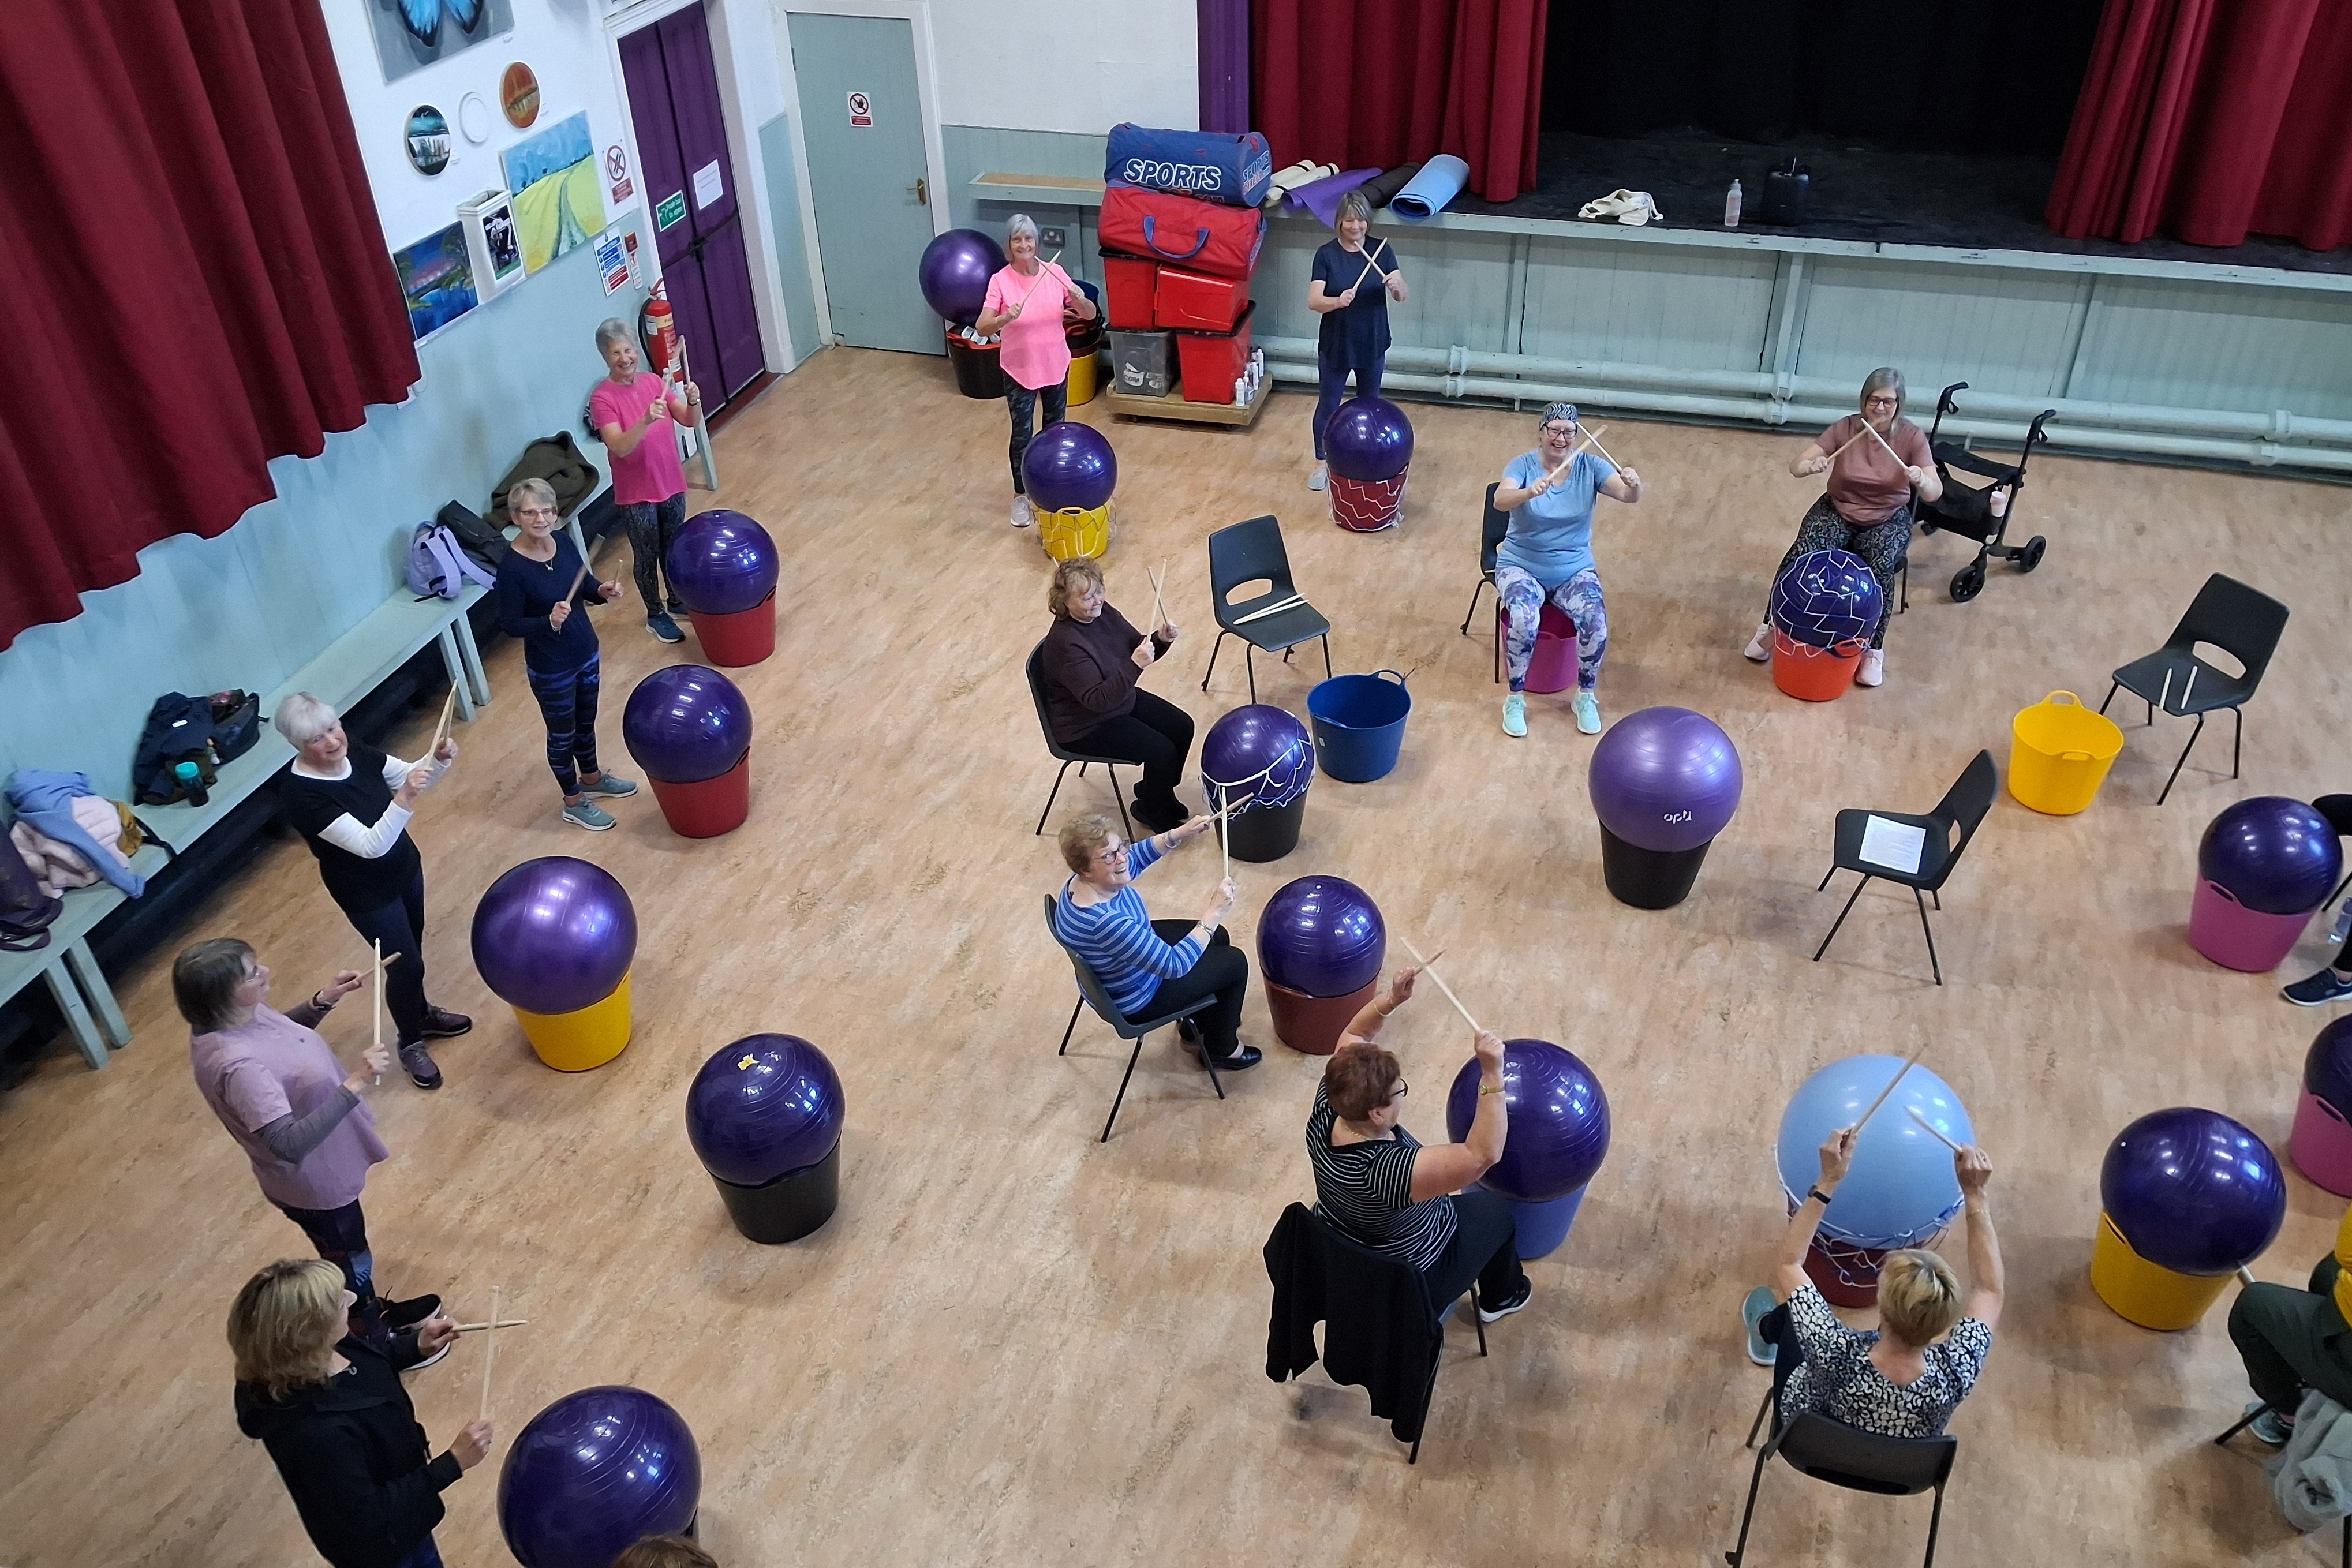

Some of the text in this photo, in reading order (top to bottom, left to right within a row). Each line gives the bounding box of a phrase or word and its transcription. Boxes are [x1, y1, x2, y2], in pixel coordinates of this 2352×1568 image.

[1124, 158, 1222, 190] SPORTS
[1243, 150, 1269, 183] SPORTS
[1663, 809, 1692, 825] opti
